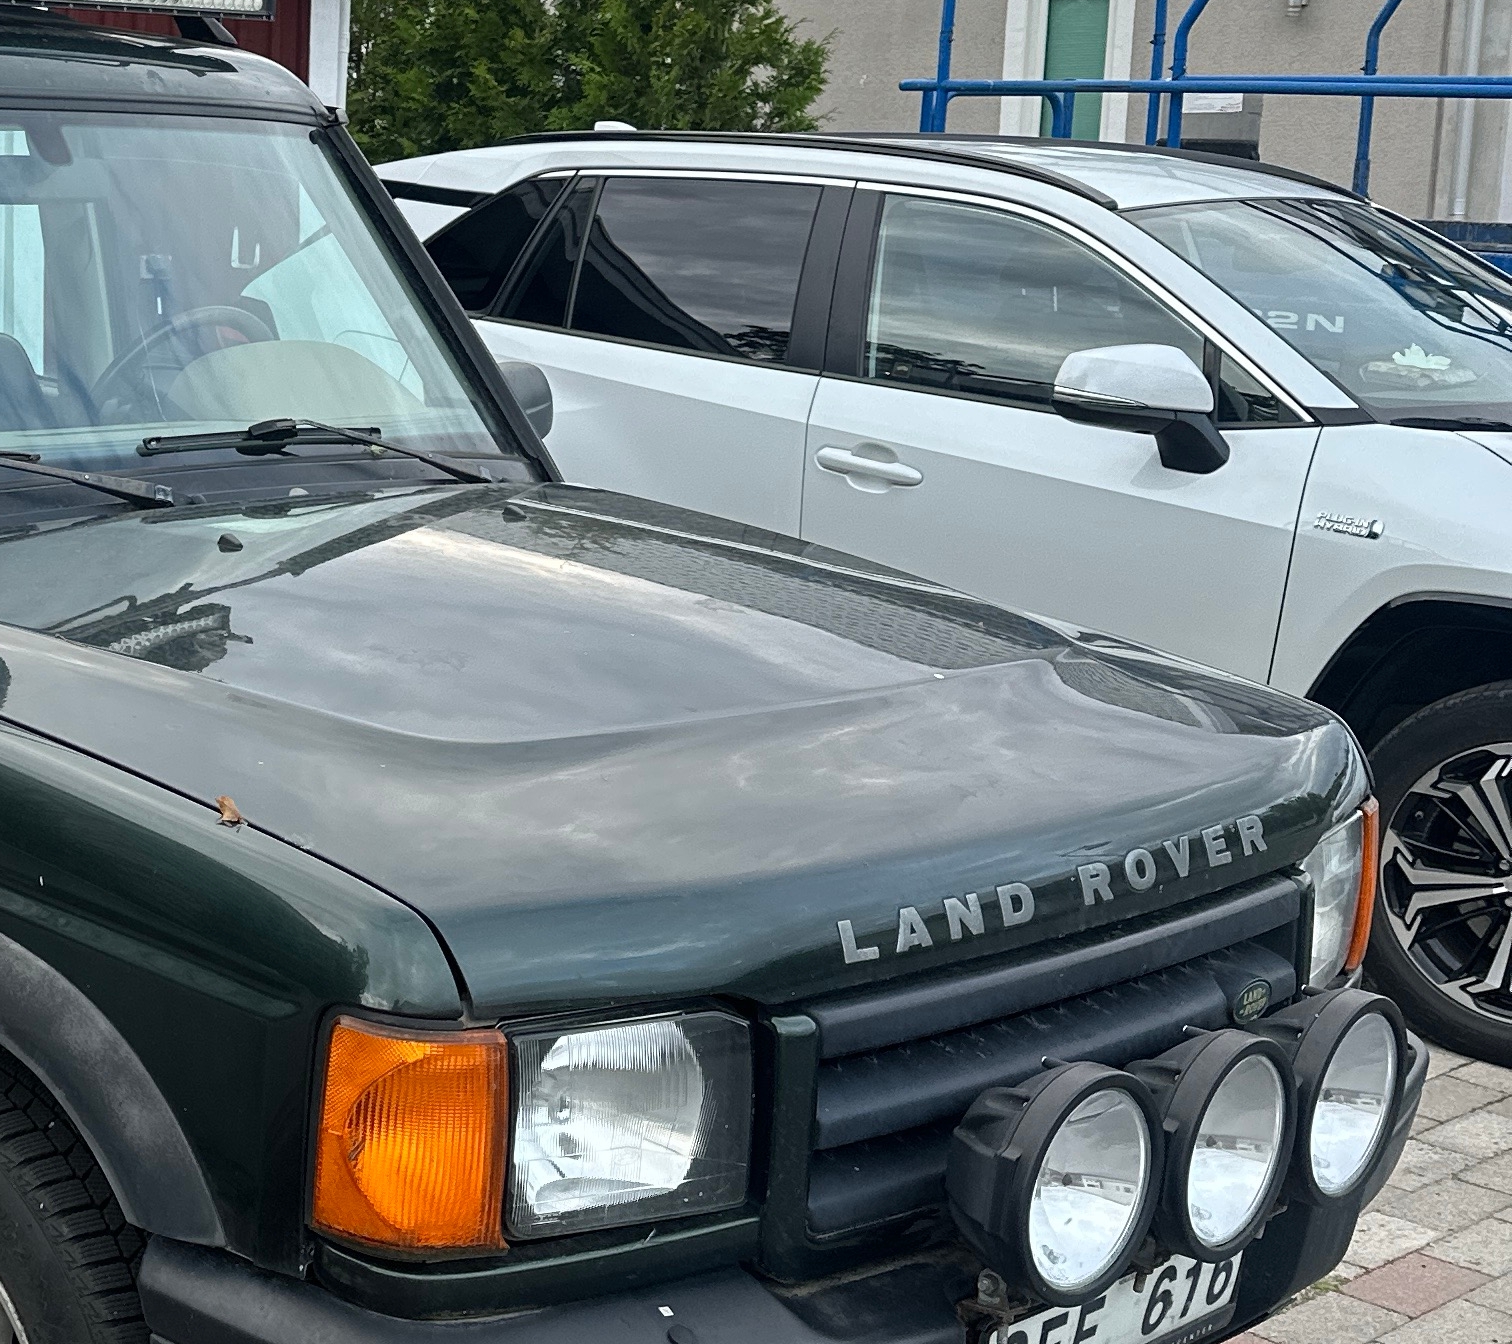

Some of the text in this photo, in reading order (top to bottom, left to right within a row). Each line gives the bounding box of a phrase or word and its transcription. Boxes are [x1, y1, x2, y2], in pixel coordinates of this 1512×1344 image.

[1313, 517, 1368, 537] HYBRID
[836, 813, 1268, 965] LAND ROVER
[1140, 1258, 1234, 1337] 616
